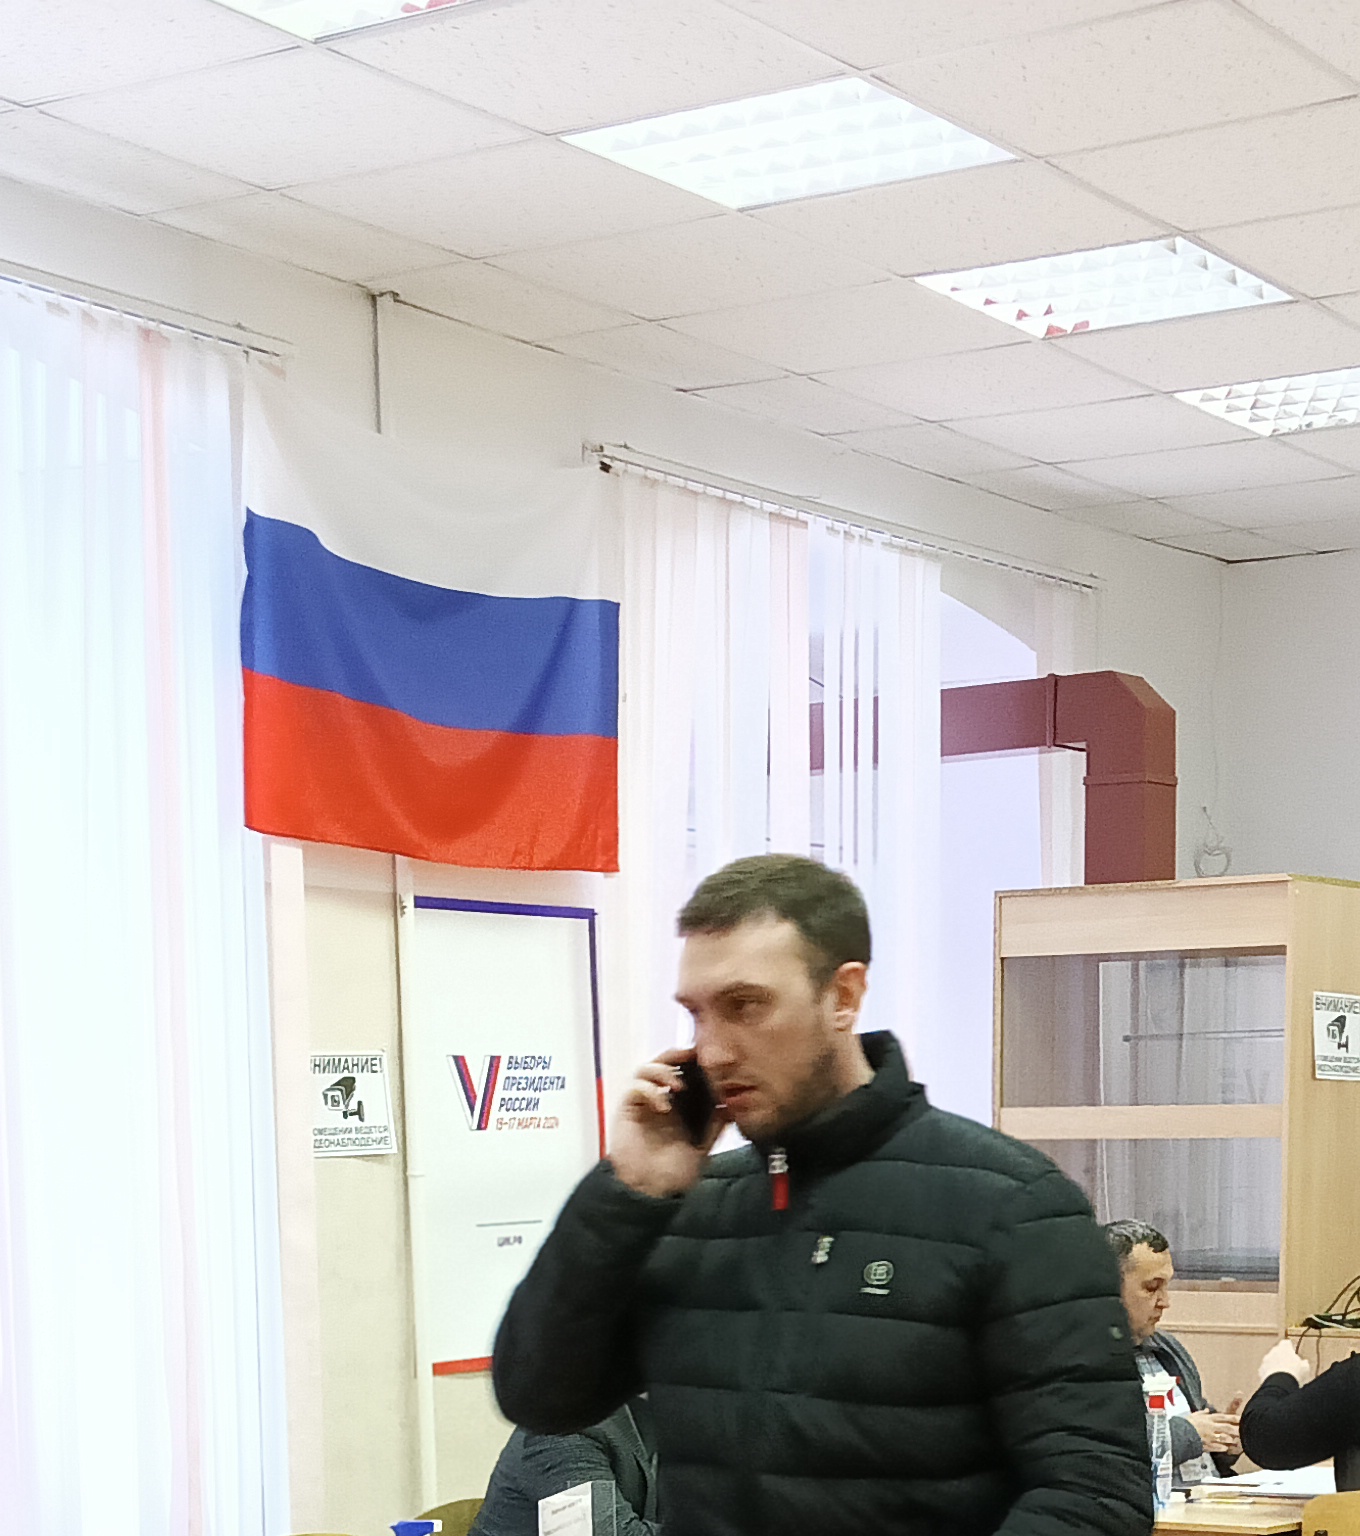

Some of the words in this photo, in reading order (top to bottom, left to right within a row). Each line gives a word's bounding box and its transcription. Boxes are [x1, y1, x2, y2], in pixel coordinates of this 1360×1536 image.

[506, 1055, 552, 1071] ВЫБОРЫ
[502, 1075, 566, 1092] ПРЕЗИДЕНТА
[498, 1096, 540, 1112] РОССИИ
[312, 1126, 353, 1136] ОМЕЩЕНИИ
[313, 1136, 390, 1149] ДЕОНАБЛЮДЕНИЕ
